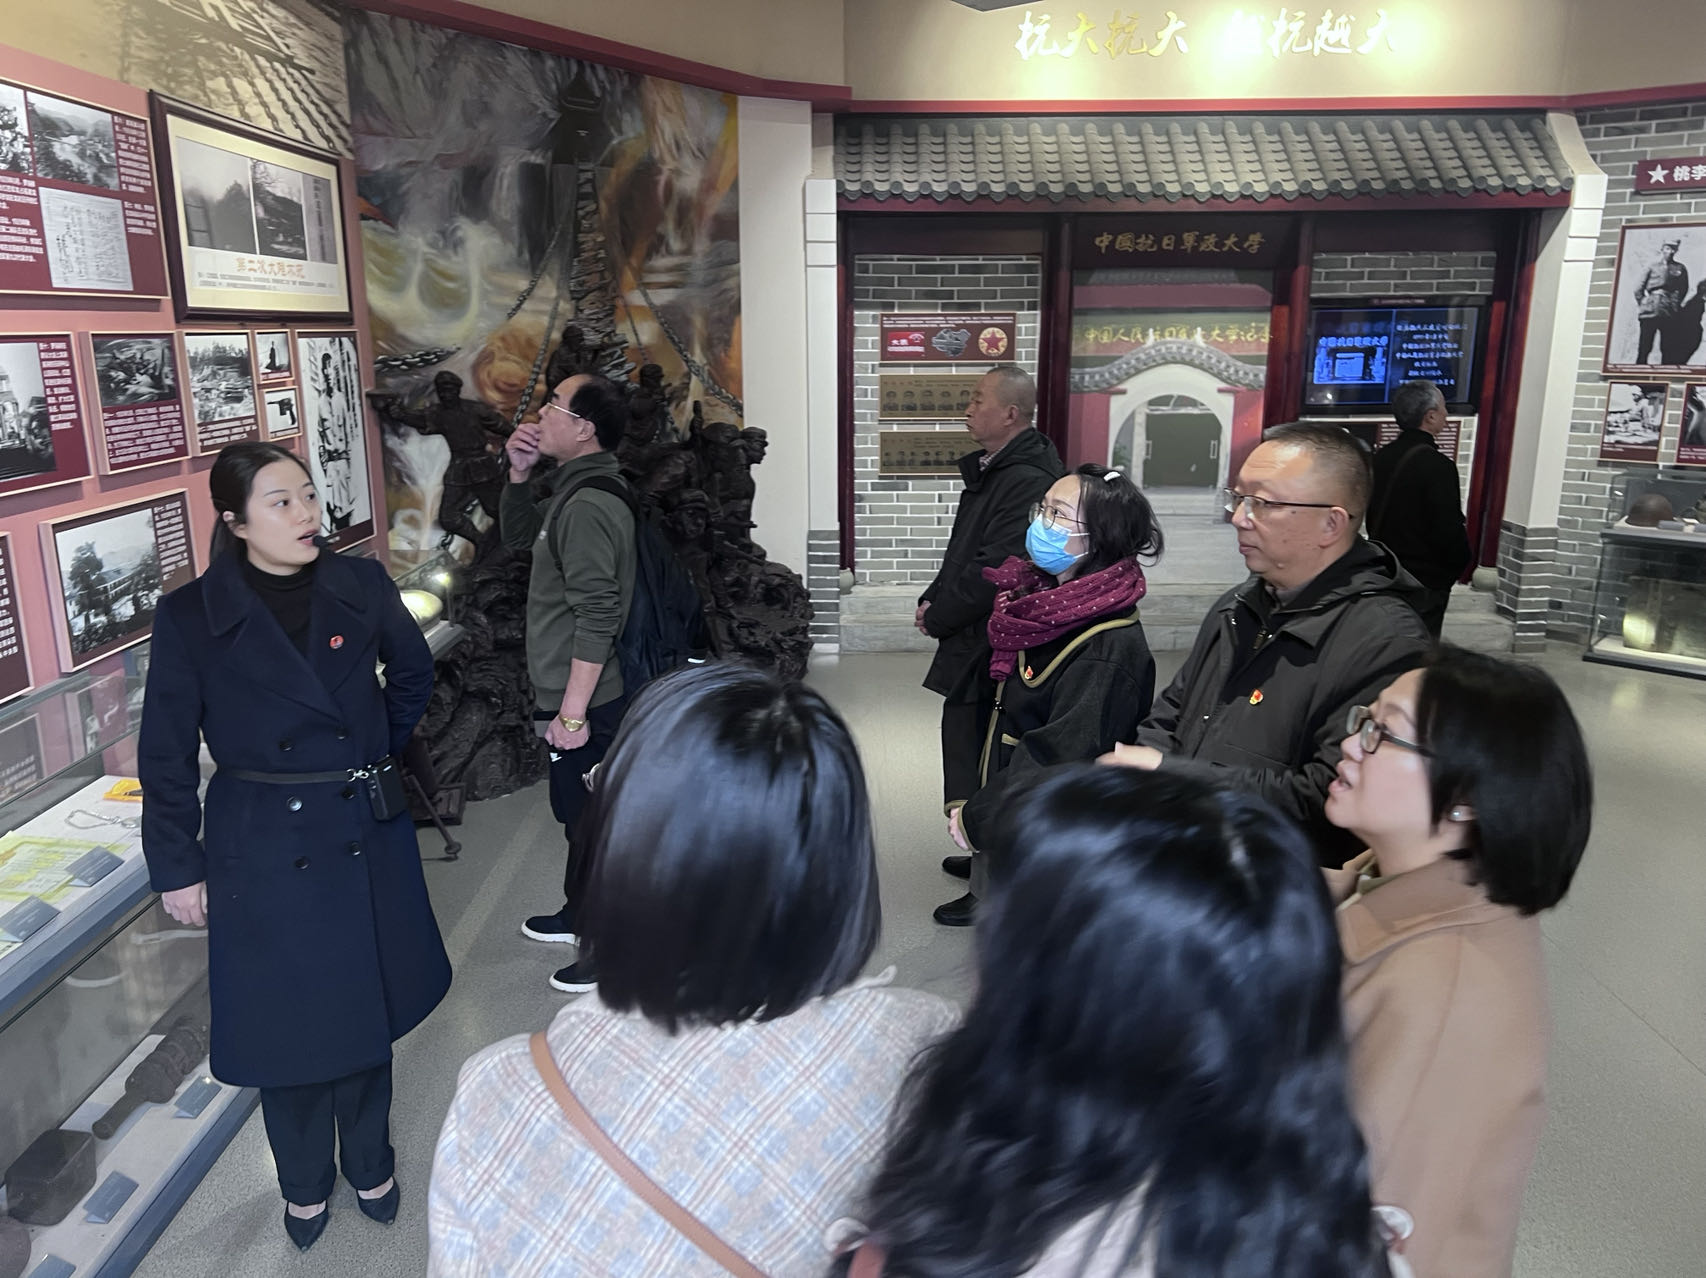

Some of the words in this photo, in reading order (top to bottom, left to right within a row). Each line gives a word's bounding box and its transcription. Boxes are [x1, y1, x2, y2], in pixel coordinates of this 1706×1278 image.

[1014, 10, 1190, 60] 抗大抗大
[1223, 8, 1398, 59] 抗越大
